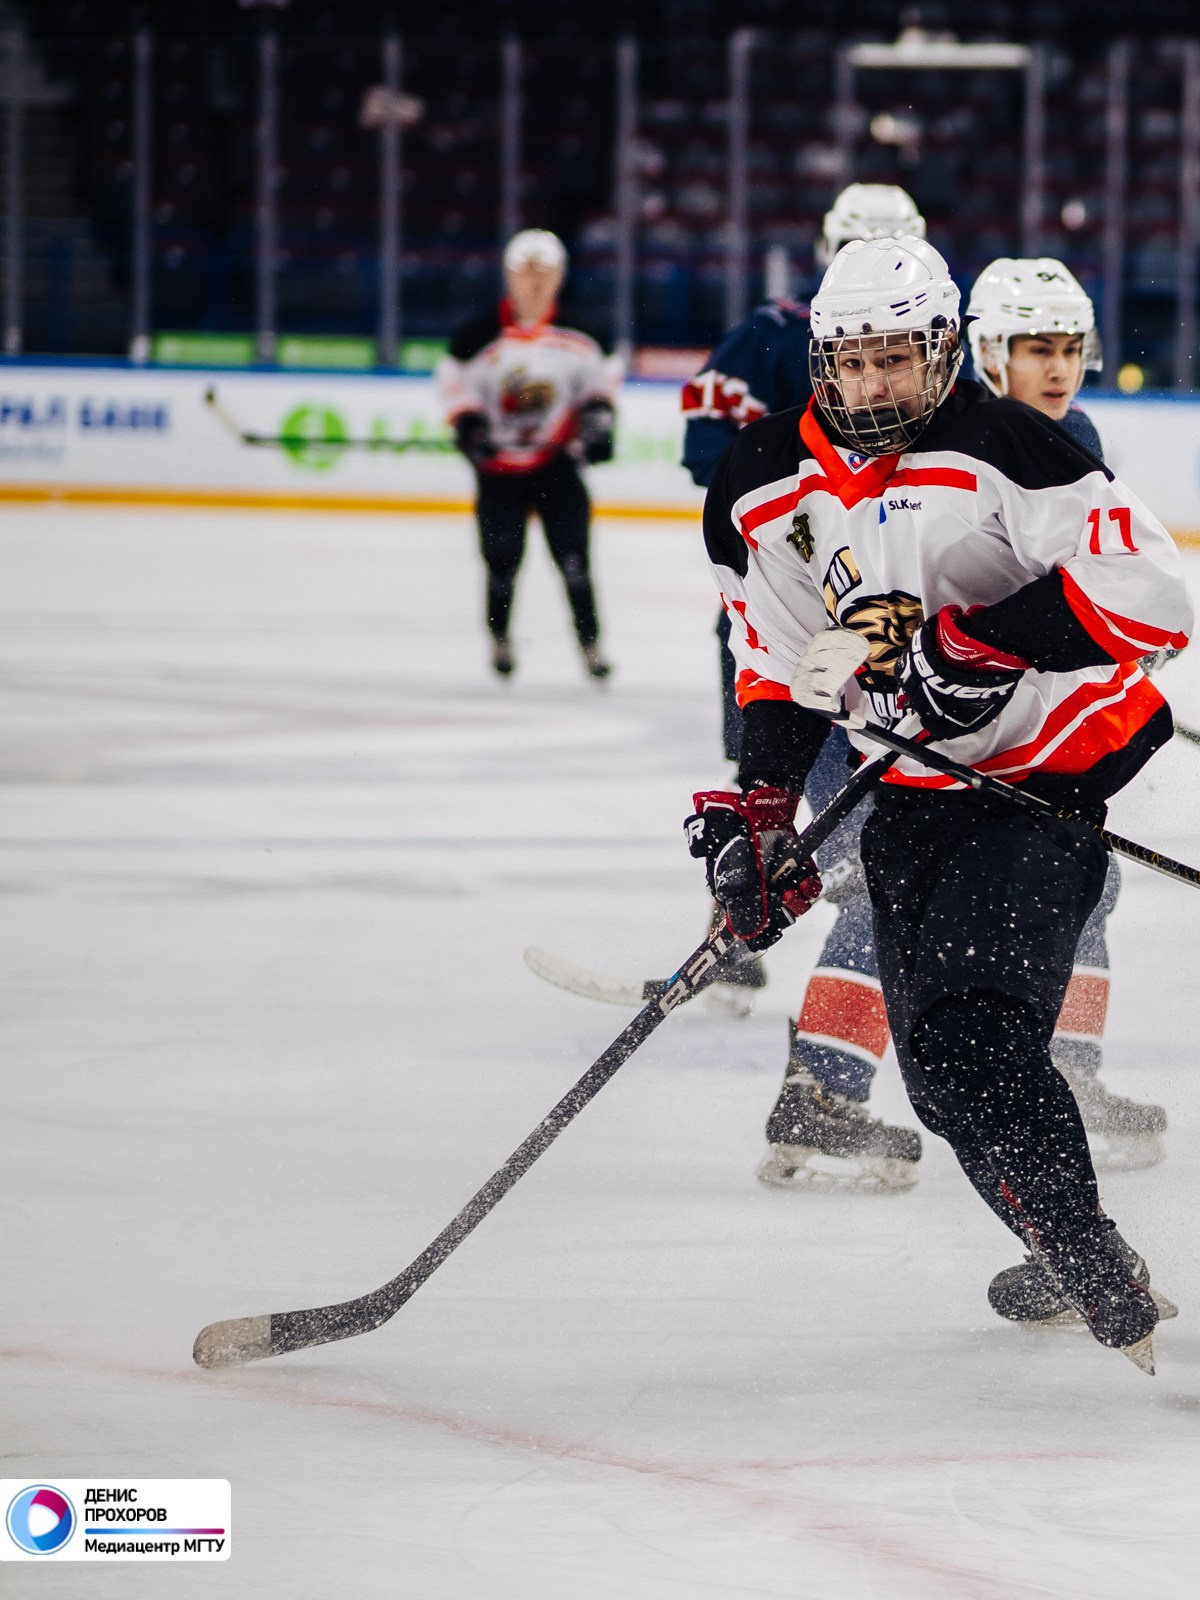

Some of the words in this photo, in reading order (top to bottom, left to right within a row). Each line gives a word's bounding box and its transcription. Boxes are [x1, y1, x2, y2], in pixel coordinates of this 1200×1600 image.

[888, 498, 910, 511] SLK
[1087, 507, 1140, 555] 11
[911, 628, 1016, 700] BAUER
[755, 797, 788, 806] BAUER
